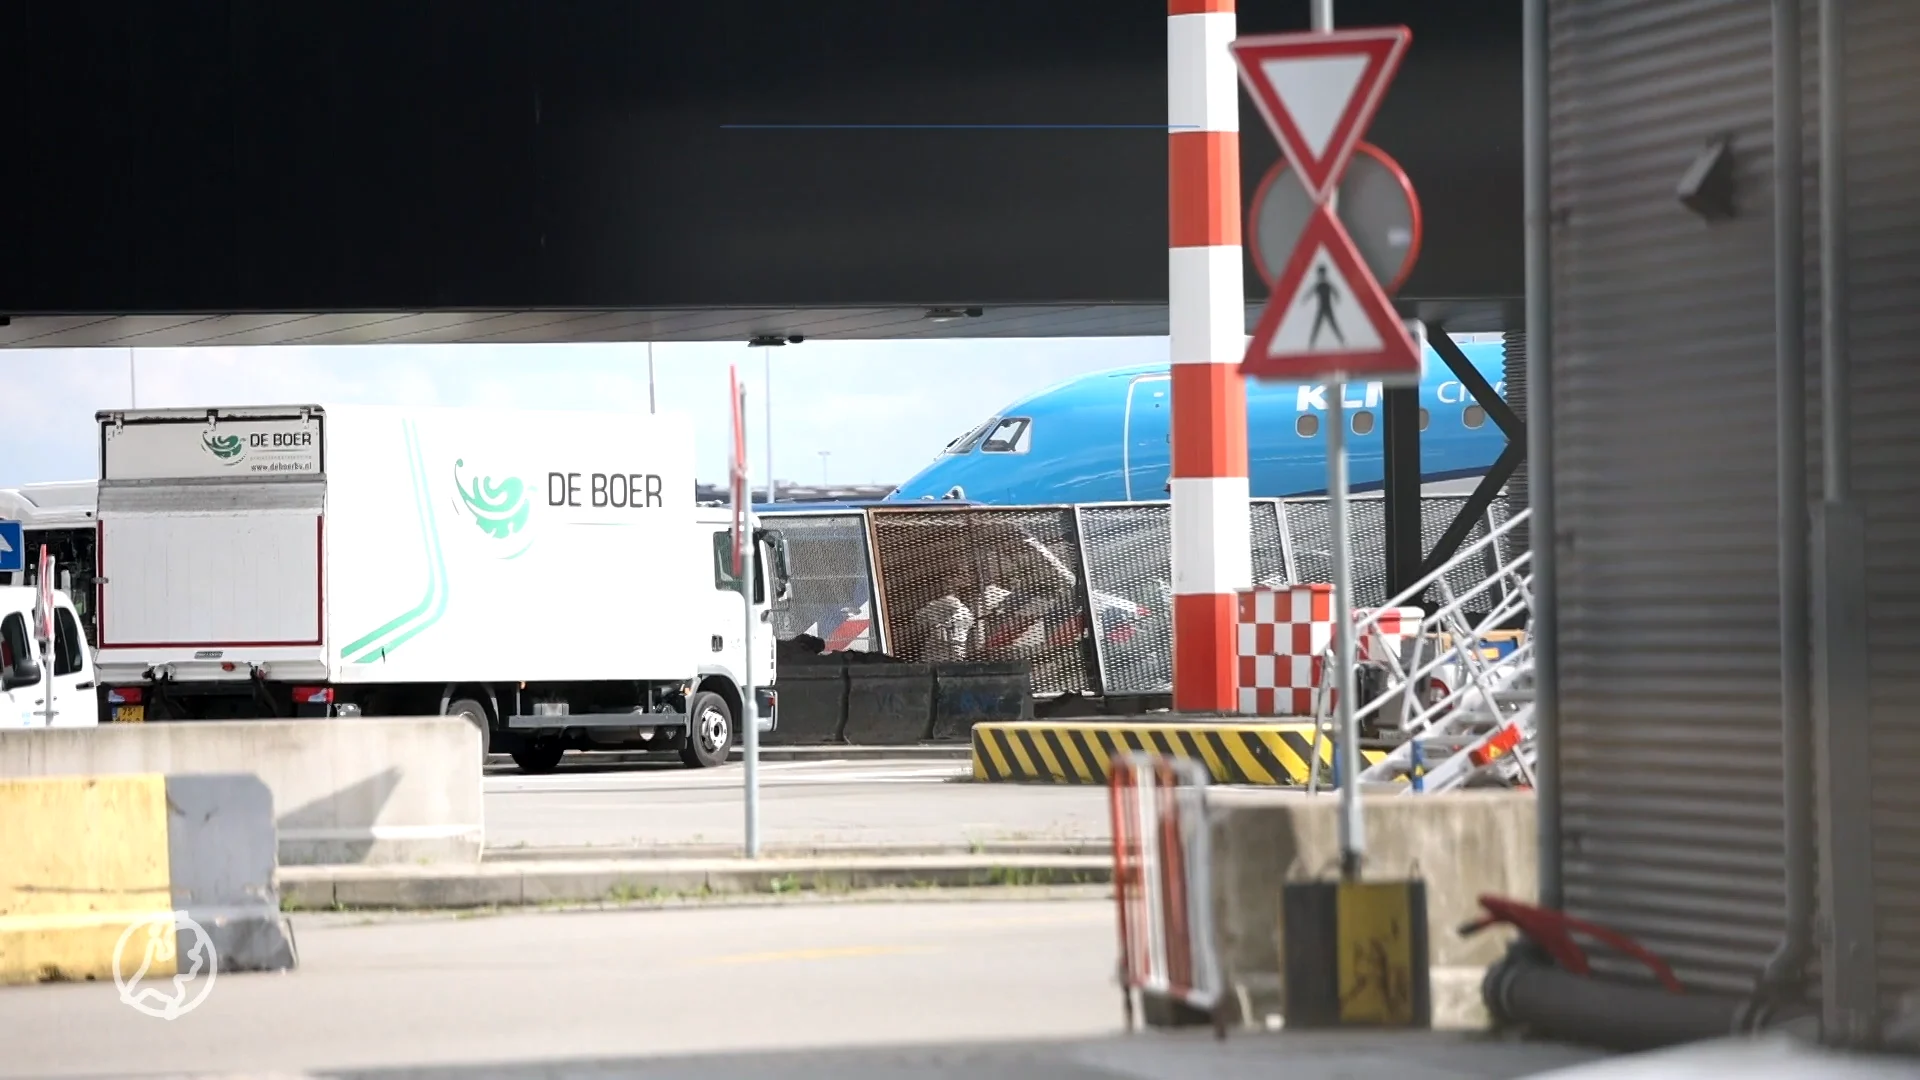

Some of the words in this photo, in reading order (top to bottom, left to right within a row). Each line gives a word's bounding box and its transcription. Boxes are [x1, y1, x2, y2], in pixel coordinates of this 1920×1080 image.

[250, 433, 269, 447] DE
[273, 432, 311, 446] BOER
[548, 471, 582, 507] DE
[591, 473, 663, 508] BOER
